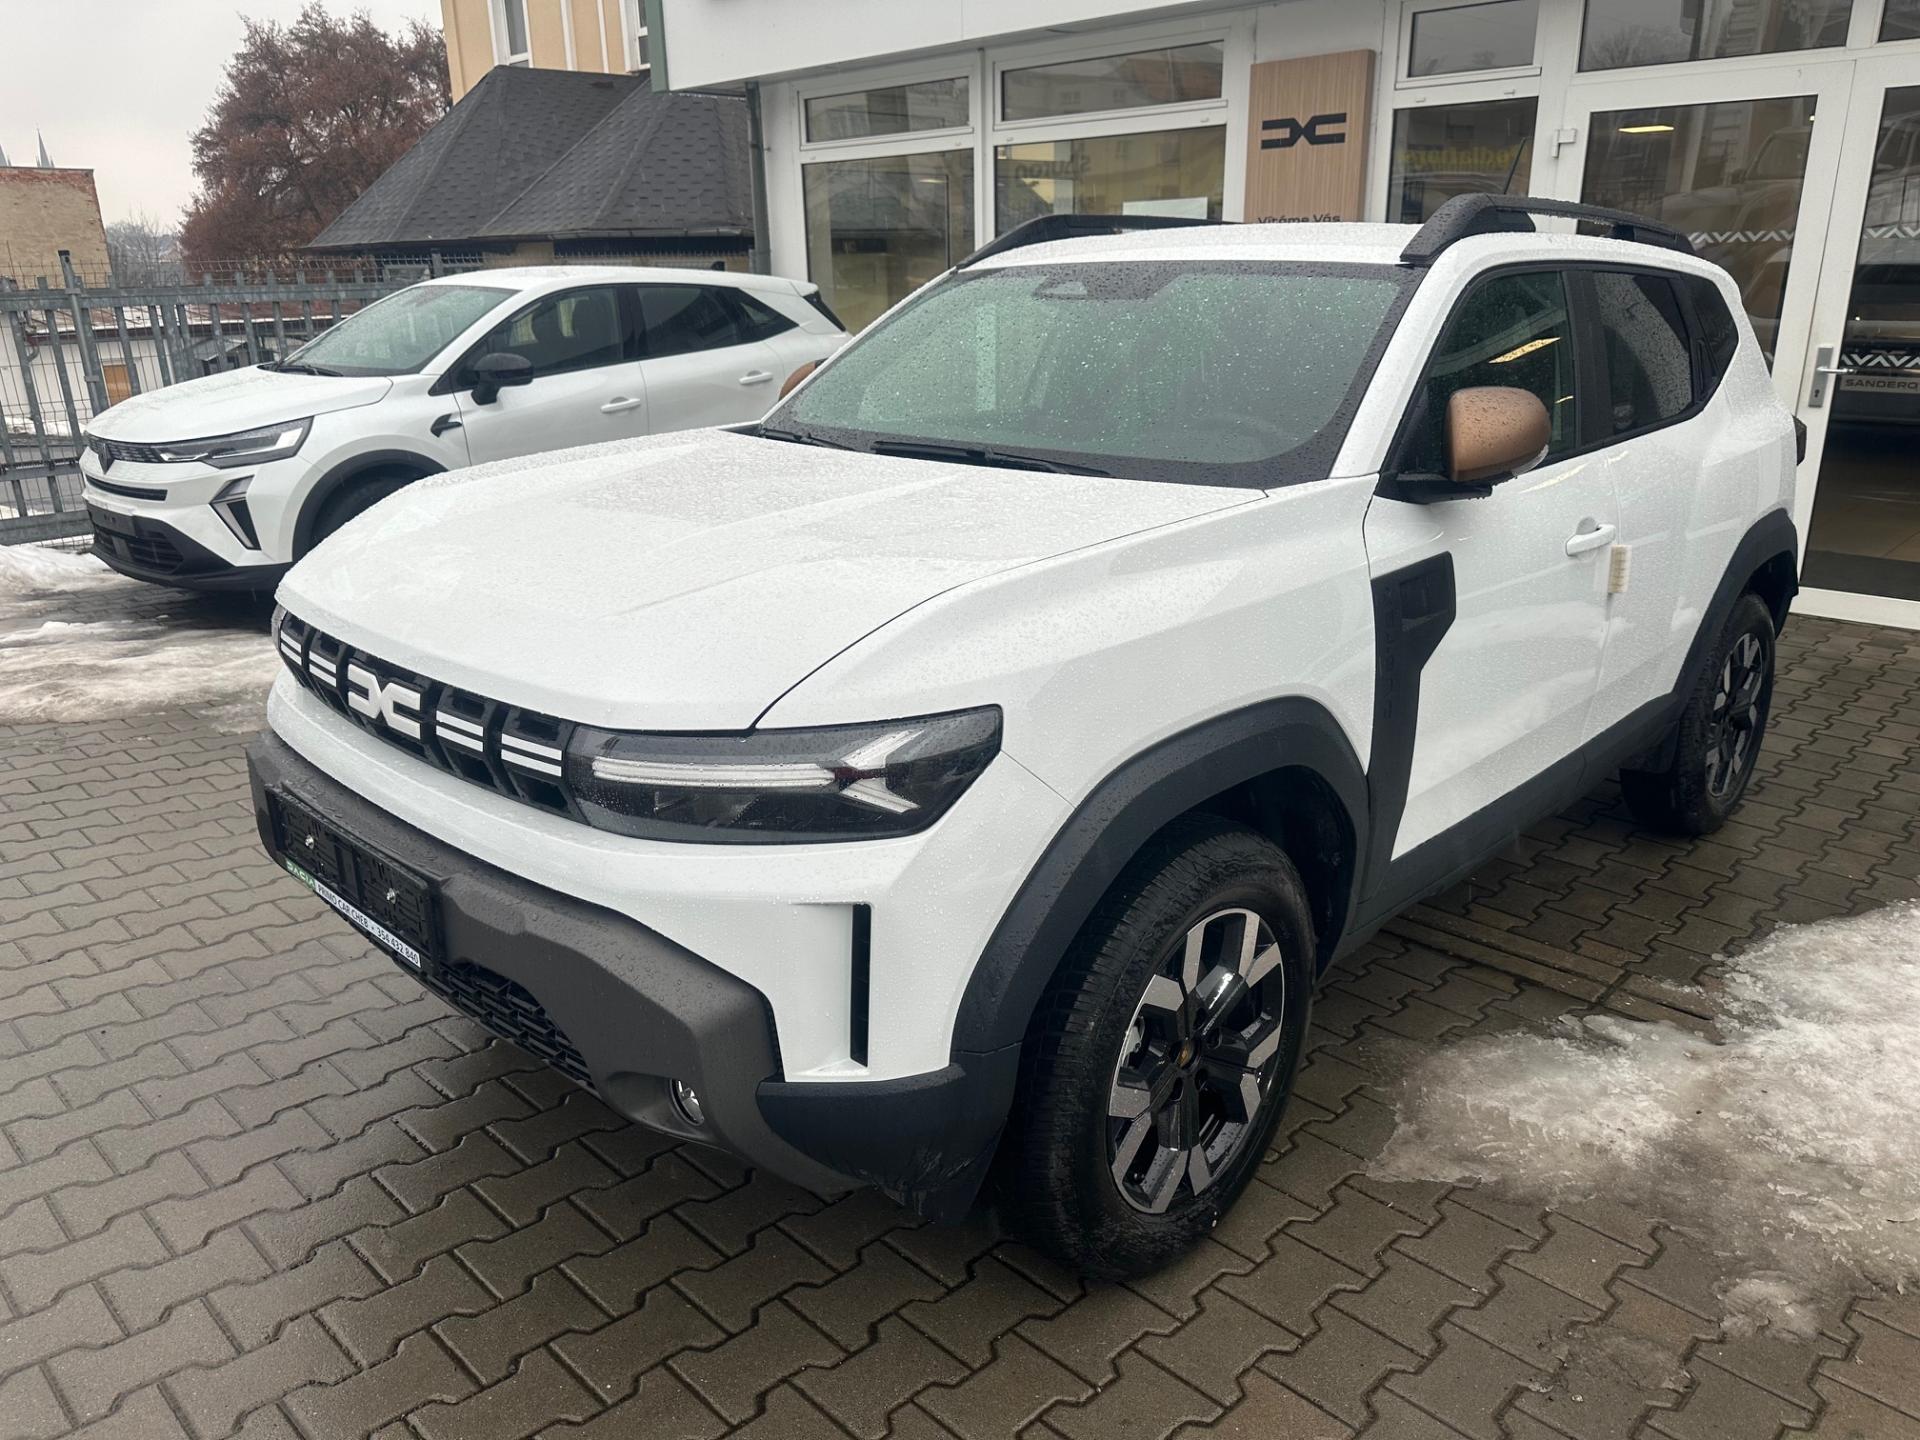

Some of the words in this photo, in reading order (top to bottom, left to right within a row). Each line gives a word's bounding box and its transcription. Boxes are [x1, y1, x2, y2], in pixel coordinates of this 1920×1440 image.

[1845, 379, 1918, 390] SANDERO
[317, 884, 337, 905] PRIMO
[337, 899, 352, 914] CAR
[351, 909, 369, 929] CHEB
[376, 926, 391, 944] 354
[390, 937, 405, 955] 432
[405, 946, 420, 965] 840
